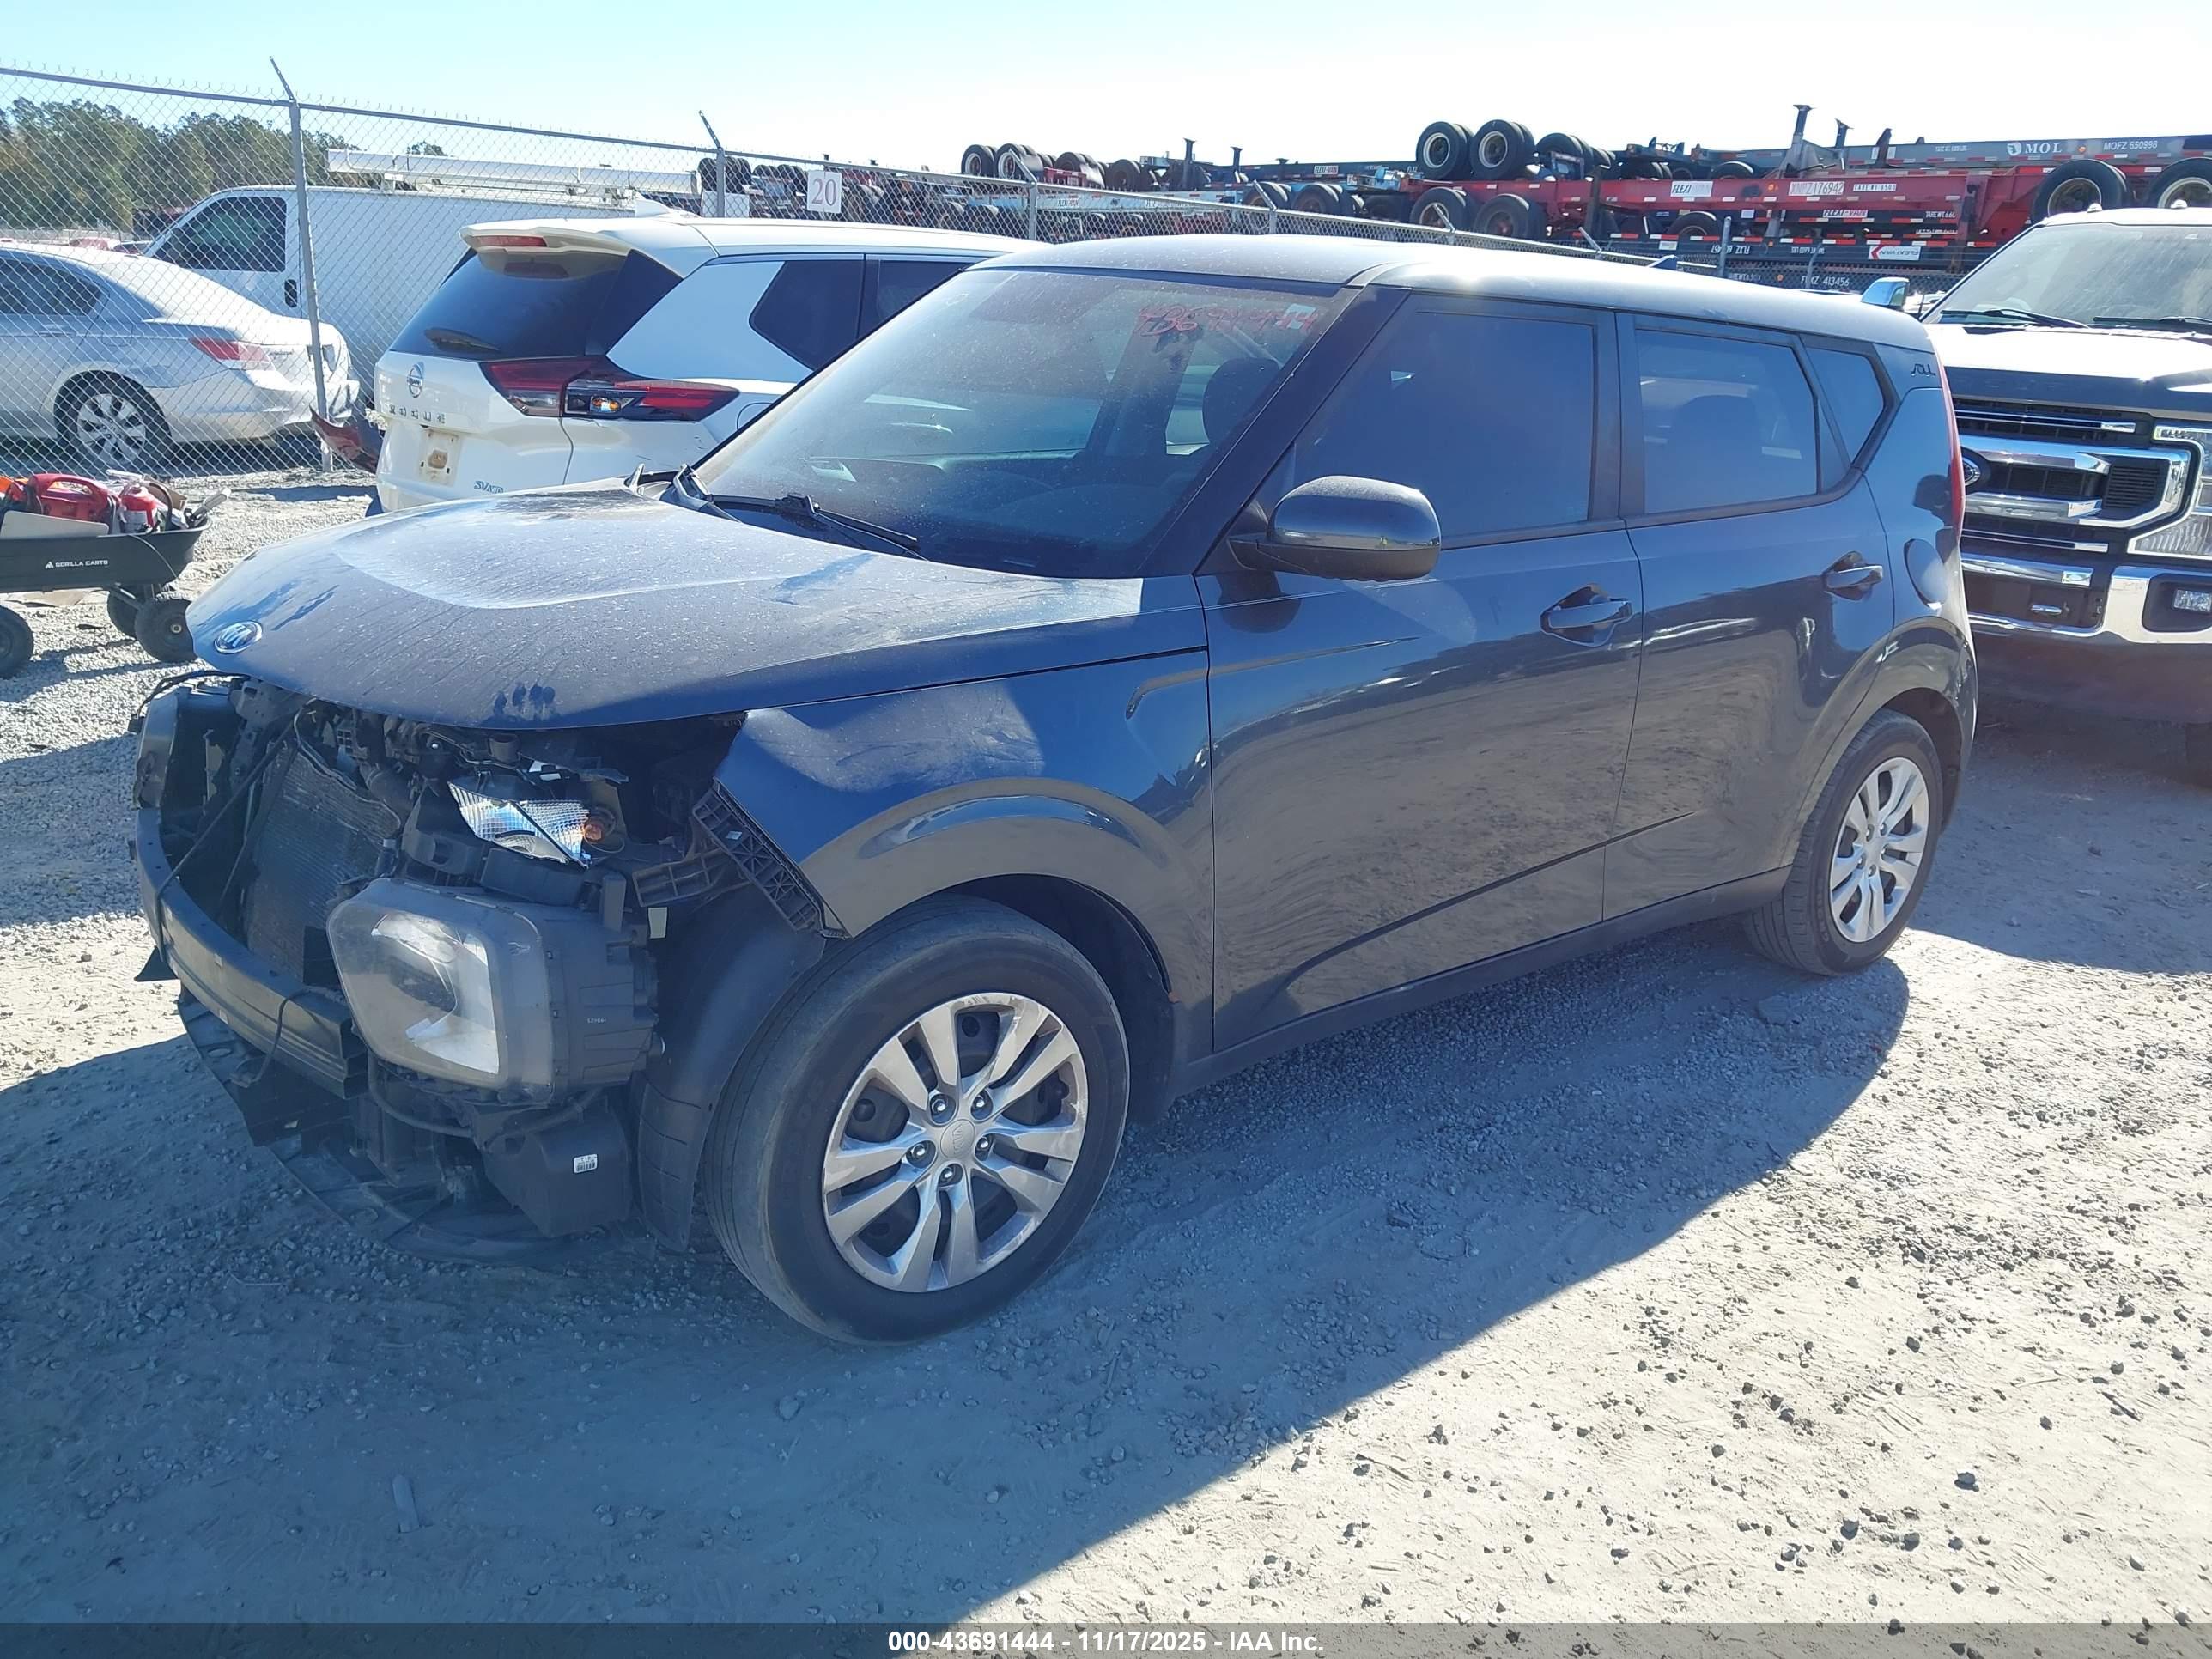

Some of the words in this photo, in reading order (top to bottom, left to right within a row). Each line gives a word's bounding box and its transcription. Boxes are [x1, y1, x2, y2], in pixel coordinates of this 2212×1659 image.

[2025, 143, 2063, 154] MOL
[2103, 142, 2127, 150] MOFZ
[2129, 140, 2158, 149] 650998
[811, 178, 837, 206] 20
[1822, 276, 1850, 287] 413456
